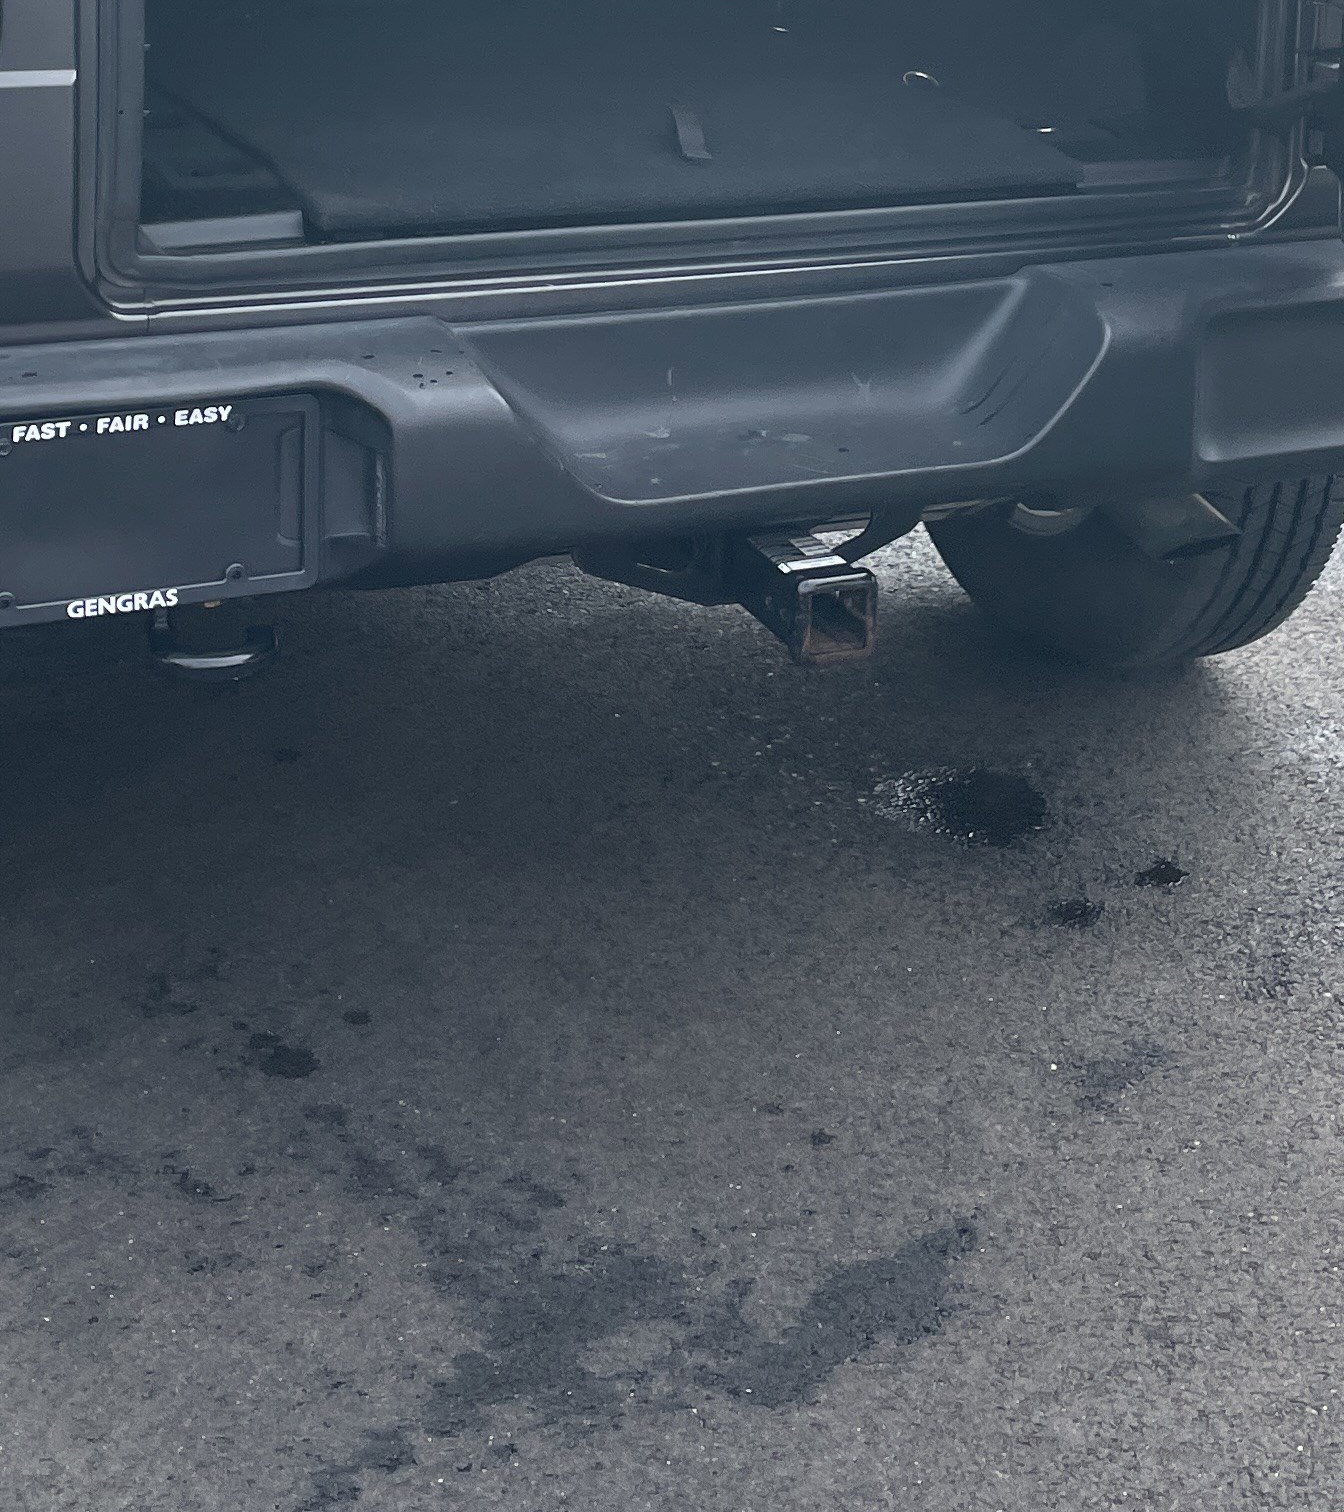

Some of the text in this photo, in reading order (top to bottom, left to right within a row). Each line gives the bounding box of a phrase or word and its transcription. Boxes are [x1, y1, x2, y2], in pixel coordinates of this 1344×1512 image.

[12, 404, 233, 443] FAST FAIR EASY
[66, 588, 179, 619] GENGRAS
